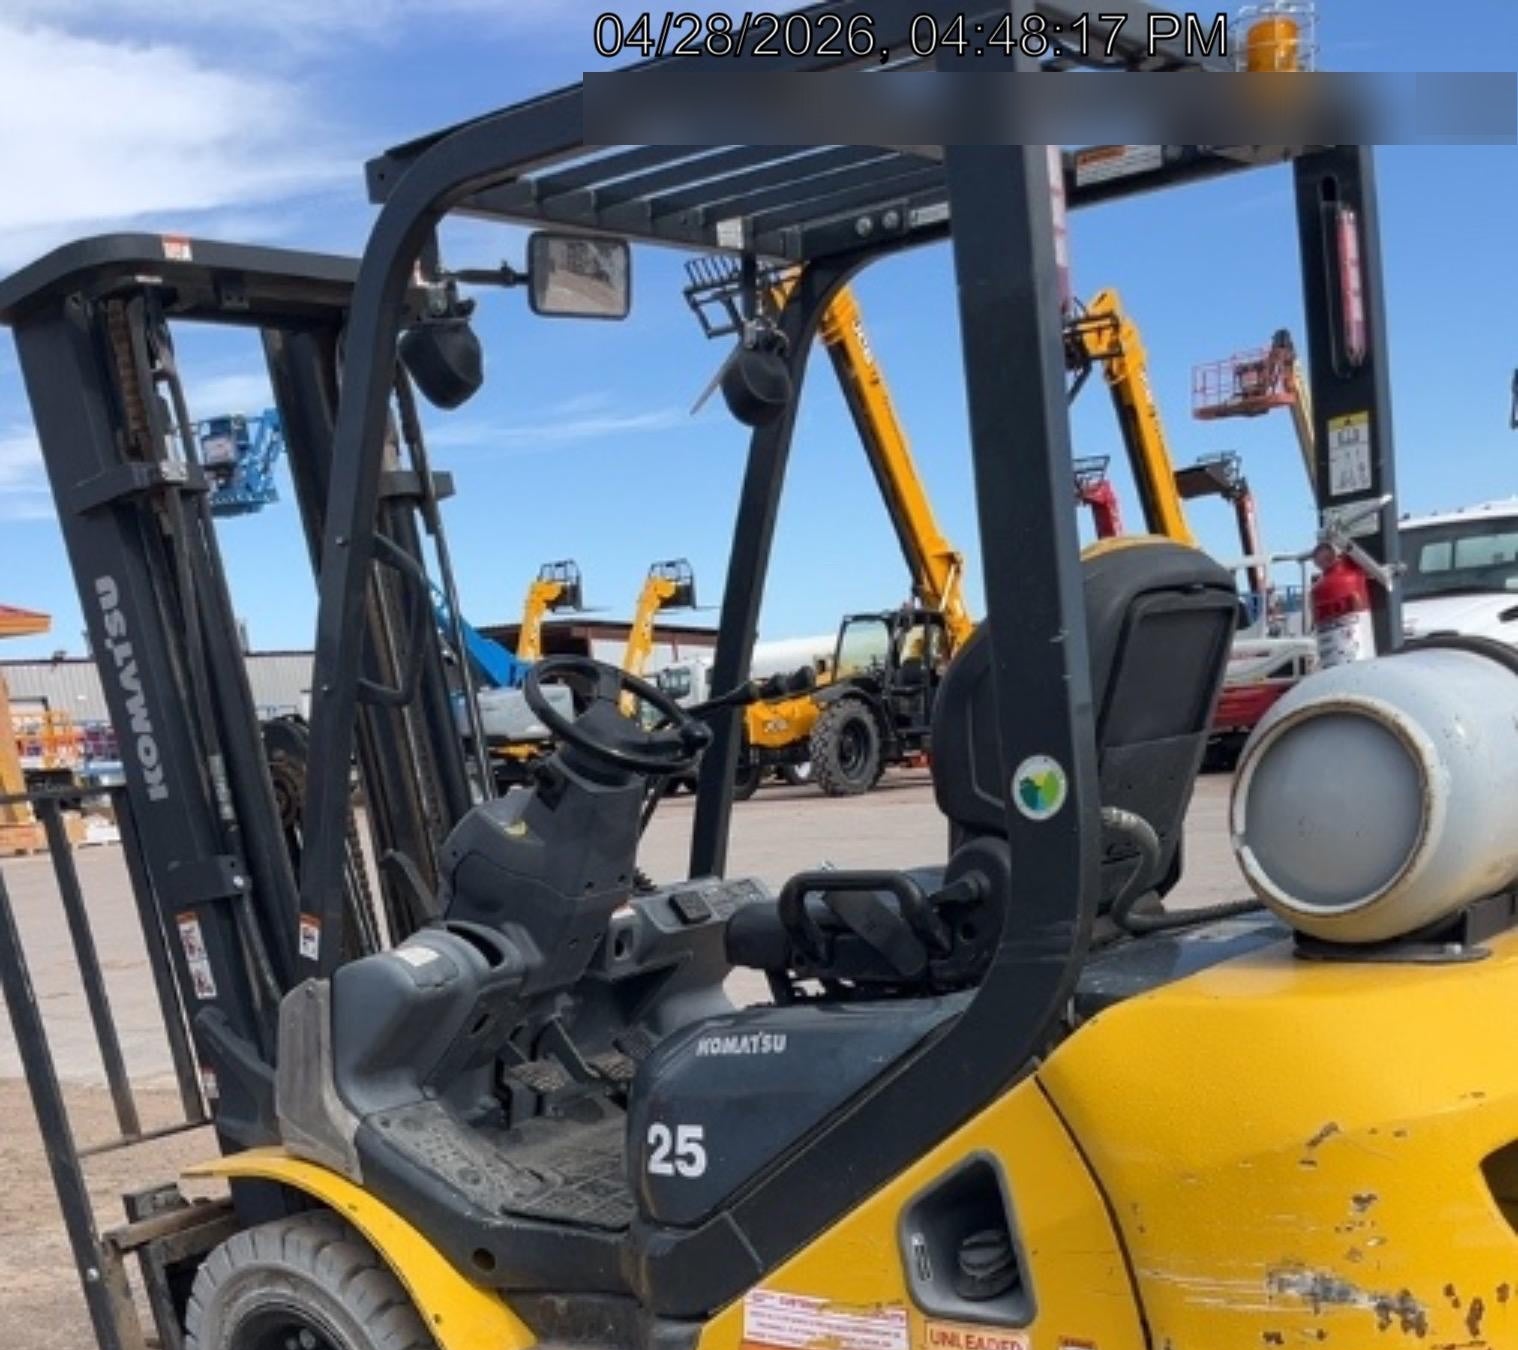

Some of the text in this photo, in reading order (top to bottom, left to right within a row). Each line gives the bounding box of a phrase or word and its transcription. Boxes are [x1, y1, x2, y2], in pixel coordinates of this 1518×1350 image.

[95, 575, 169, 801] KOMATSU
[696, 1031, 788, 1057] KOMATSU
[647, 1121, 708, 1178] 25
